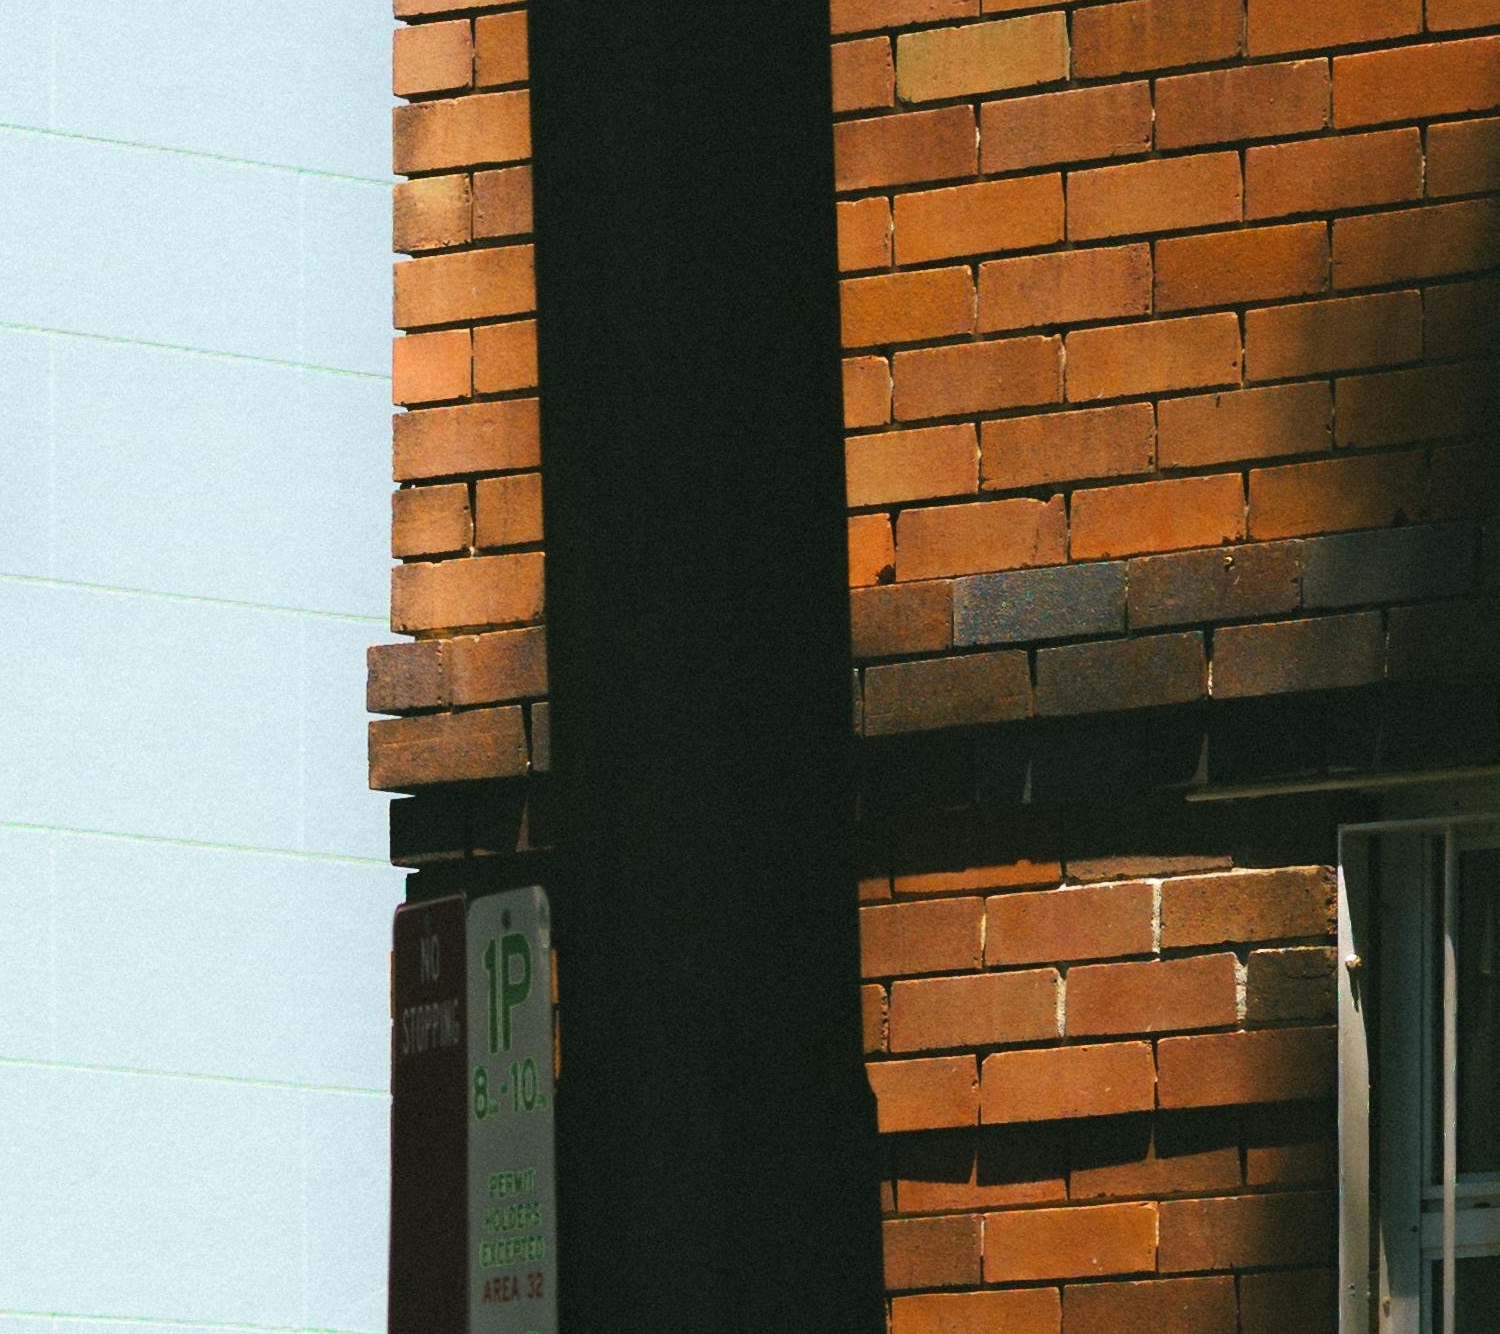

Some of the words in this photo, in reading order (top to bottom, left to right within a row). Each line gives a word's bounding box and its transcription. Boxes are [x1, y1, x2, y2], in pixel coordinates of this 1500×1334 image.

[420, 934, 440, 984] NO
[484, 932, 532, 1054] 1P
[402, 998, 460, 1054] STOPPING
[487, 1168, 534, 1198] PERMIT
[484, 1202, 542, 1232] HOLDERS
[481, 1234, 544, 1267] EXCEPTED
[483, 1275, 520, 1303] AREA
